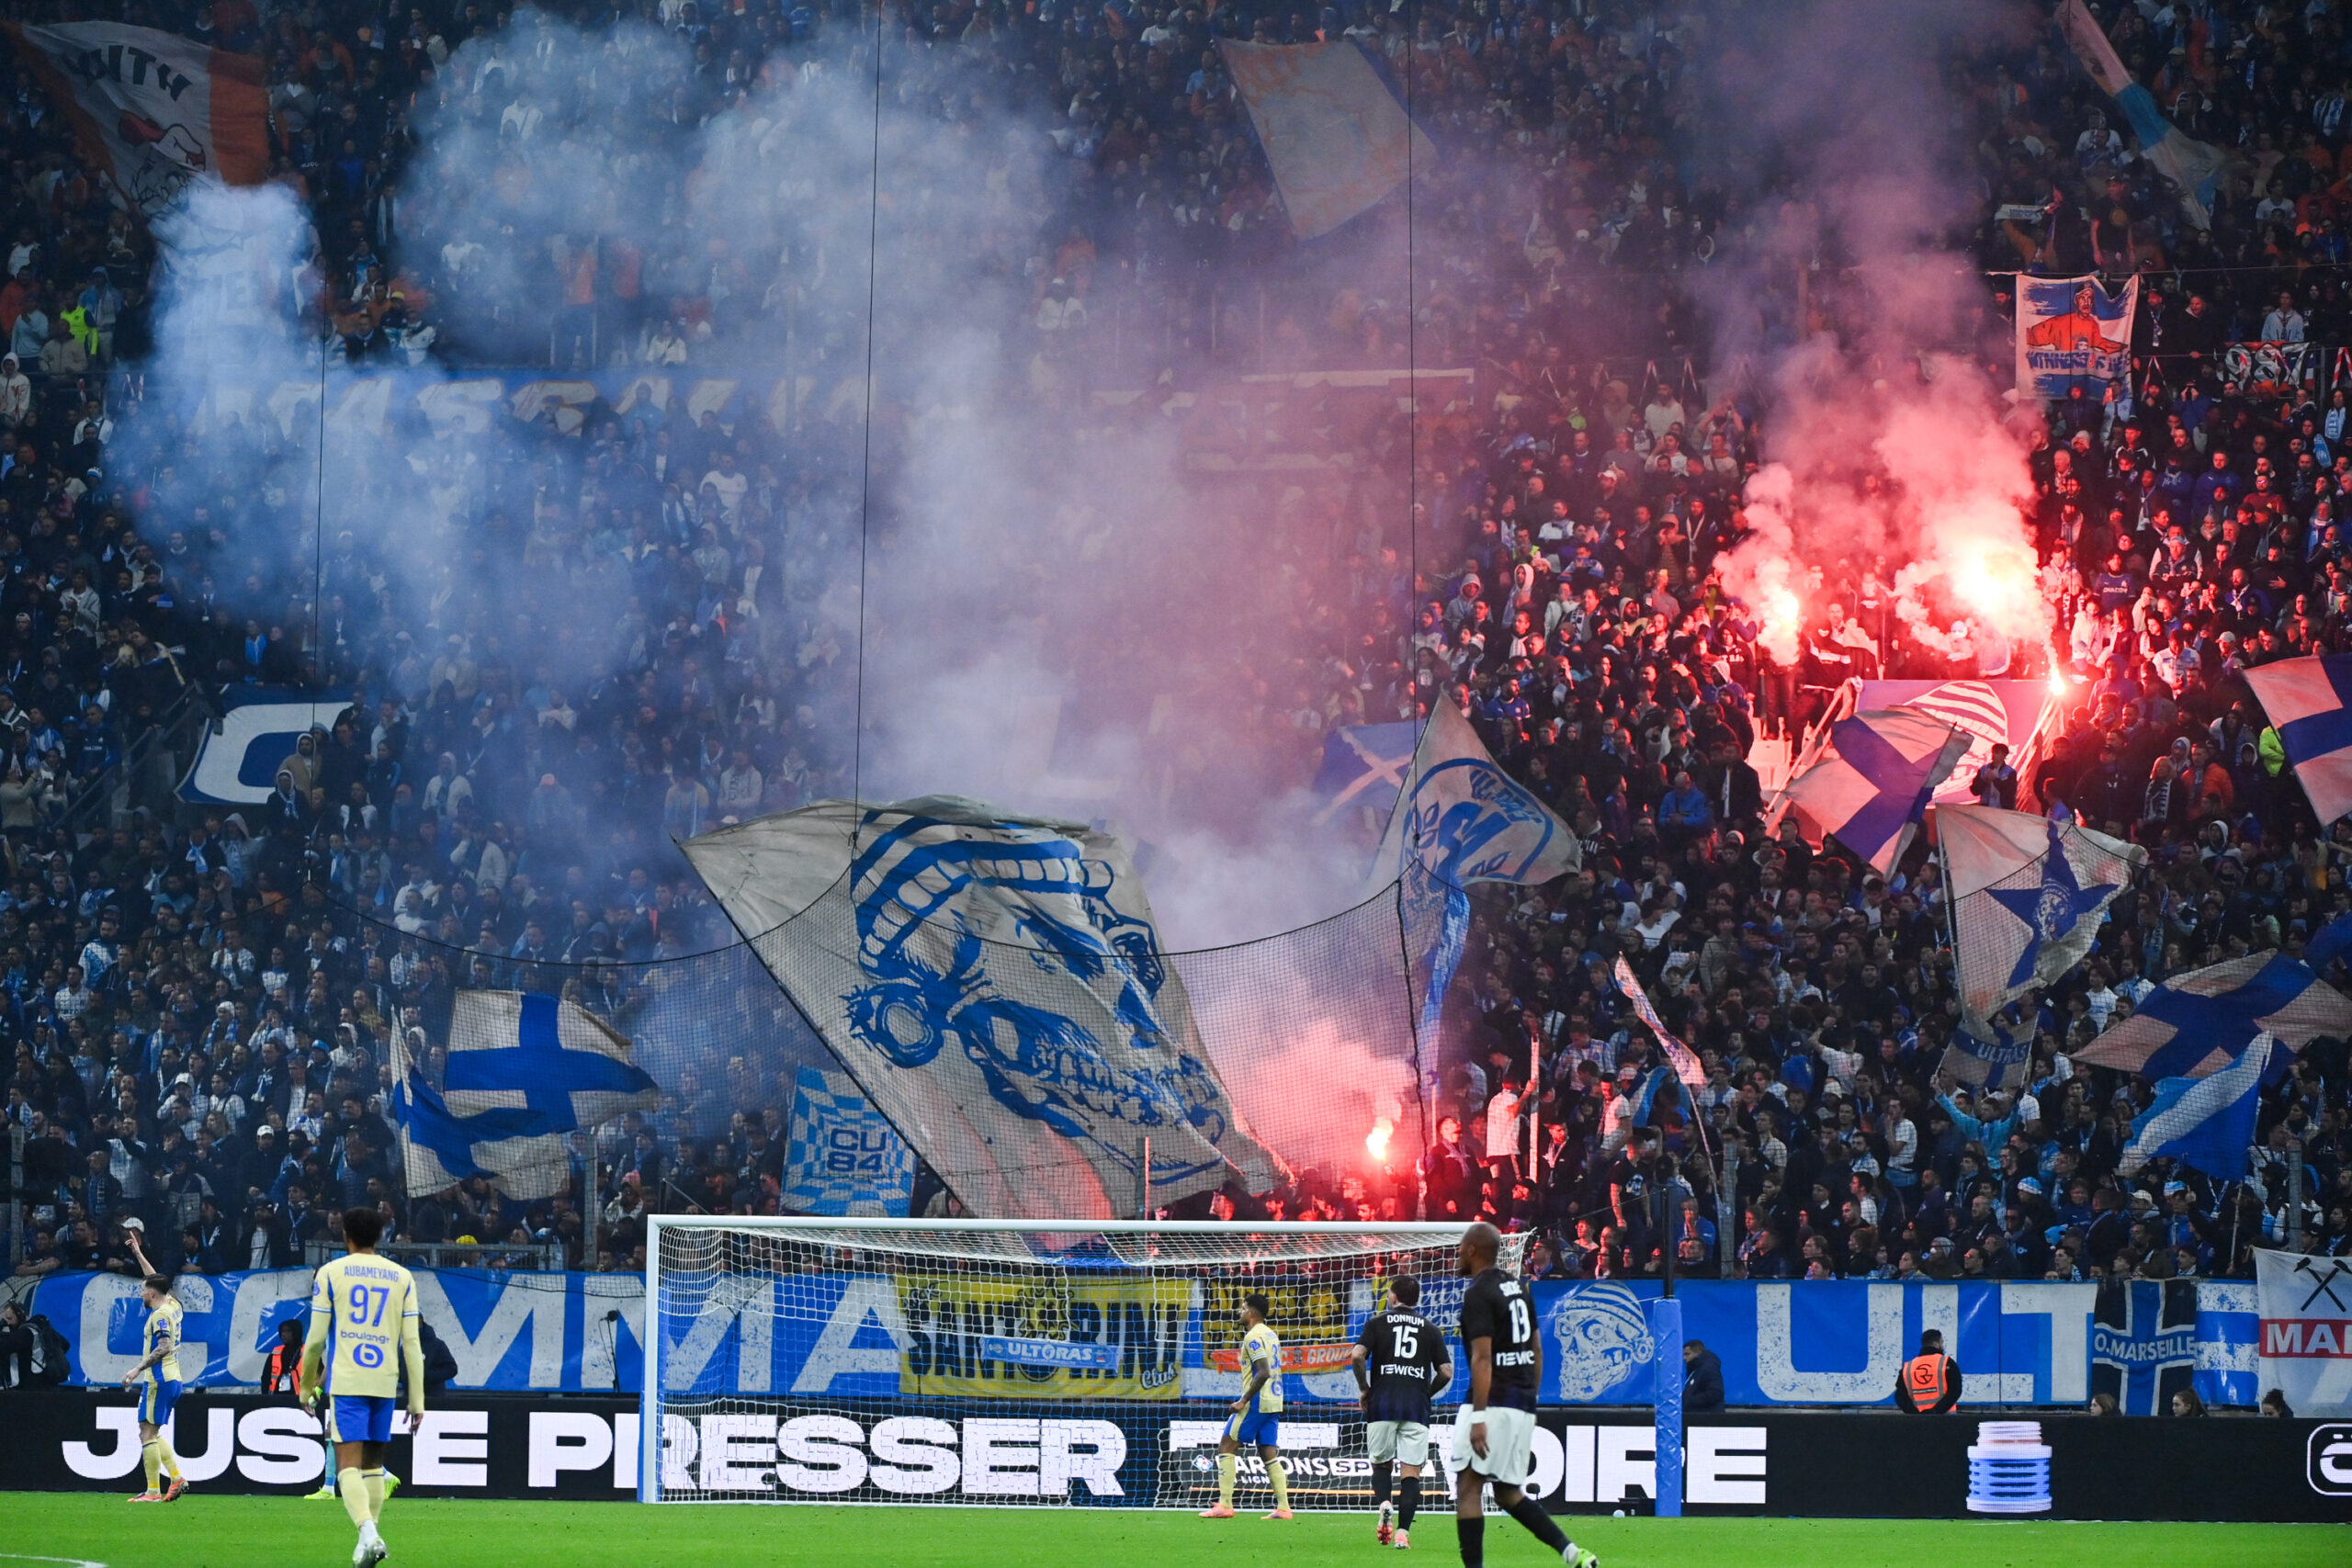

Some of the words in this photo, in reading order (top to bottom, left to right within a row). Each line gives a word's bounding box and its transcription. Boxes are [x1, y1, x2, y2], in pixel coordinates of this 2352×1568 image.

[831, 1128, 887, 1152] CU
[828, 1151, 883, 1172] 84
[344, 1265, 399, 1282] AUBAMEYANG
[349, 1284, 390, 1327] 97
[1386, 1314, 1425, 1327] DONNUM
[1392, 1325, 1419, 1359] 15
[2094, 1333, 2196, 1361] O.MARSEILLE
[2267, 1323, 2352, 1354] MA
[1140, 1368, 1178, 1391] Club
[62, 1406, 488, 1487] JUSE
[528, 1412, 1127, 1496] PRESSER
